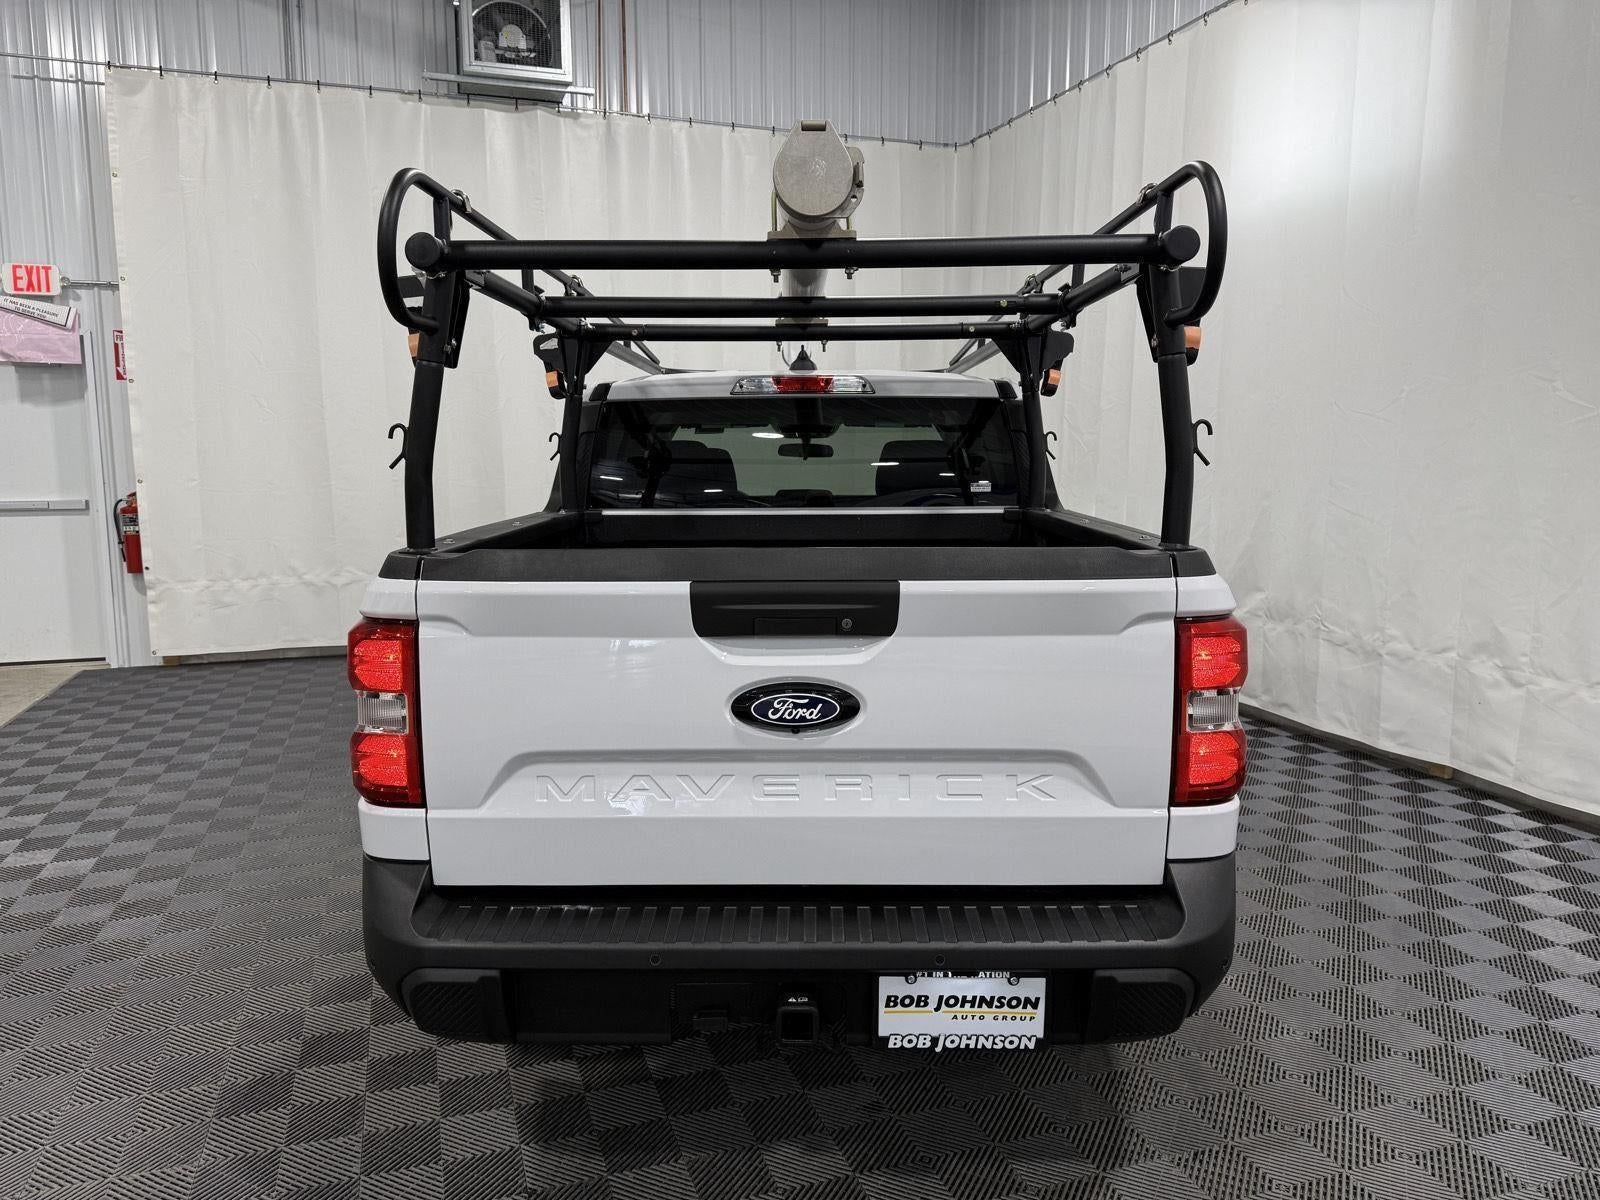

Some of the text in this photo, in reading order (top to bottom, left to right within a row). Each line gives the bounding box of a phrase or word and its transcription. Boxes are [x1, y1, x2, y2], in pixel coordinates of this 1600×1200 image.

[12, 264, 52, 293] EXIT
[768, 697, 823, 719] Ford
[535, 773, 1057, 803] MAVERICK
[976, 971, 1011, 979] ATION
[884, 994, 1041, 1012] BOB JOHNSON
[887, 1034, 1037, 1052] BOB JOHNSON
